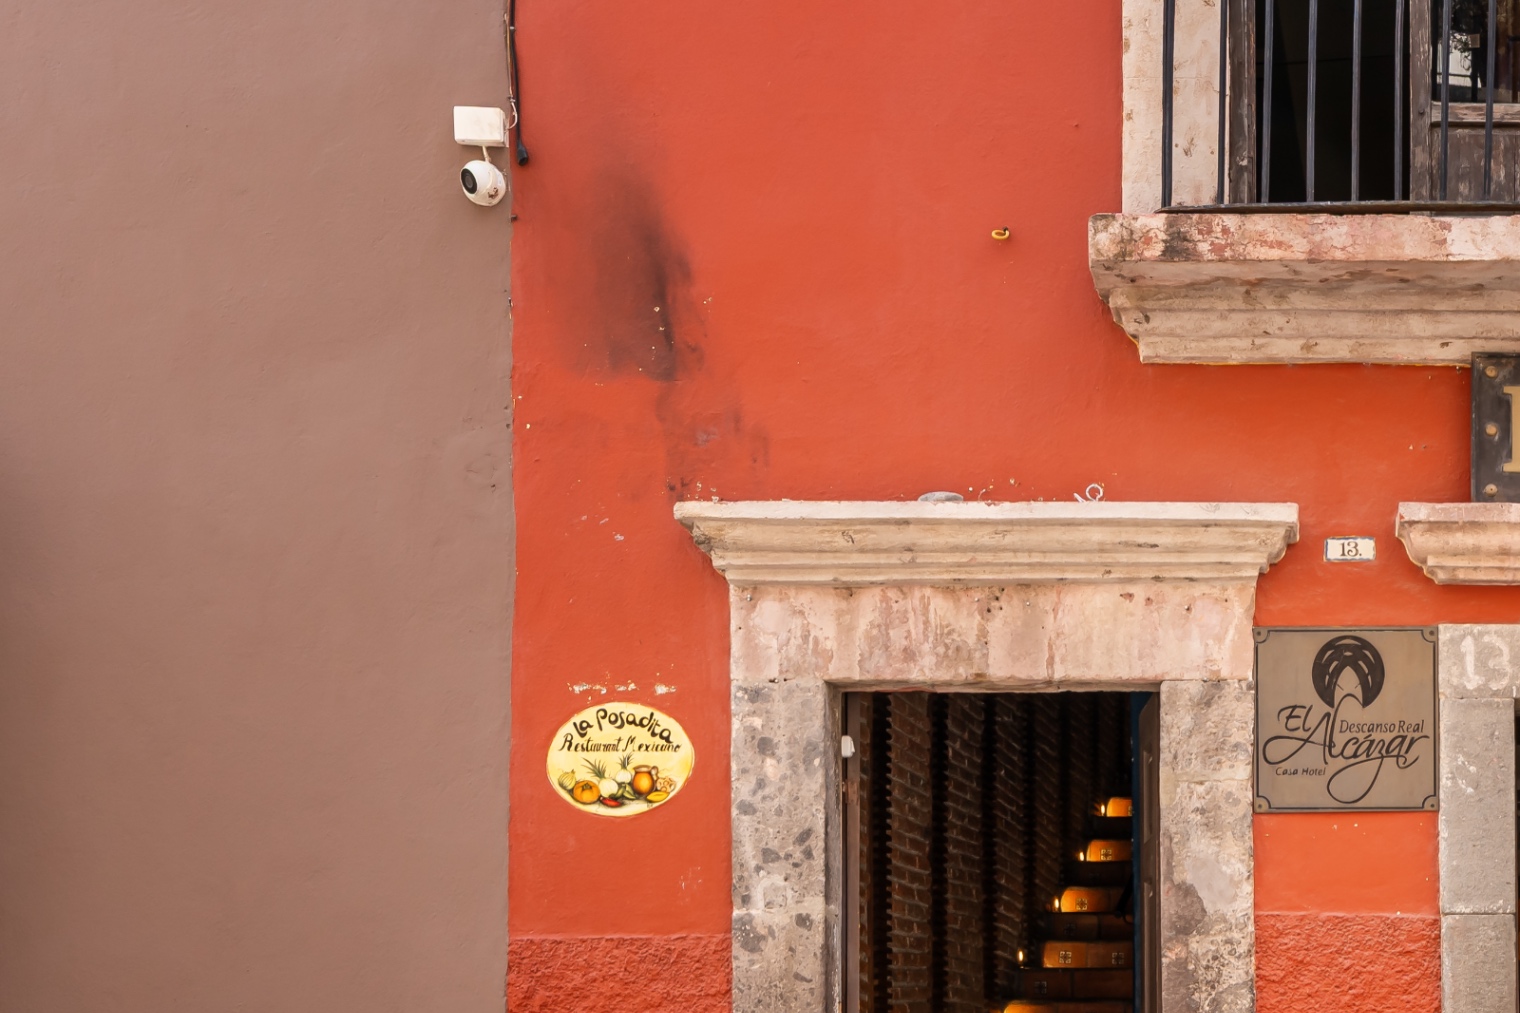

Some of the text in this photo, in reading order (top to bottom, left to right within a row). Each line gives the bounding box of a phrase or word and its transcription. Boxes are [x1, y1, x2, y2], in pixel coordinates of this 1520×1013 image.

[1459, 635, 1512, 691] 13
[596, 708, 674, 744] Posadita
[1277, 704, 1313, 733] El
[1339, 719, 1425, 734] Descanso Real
[558, 732, 682, 753] Restaurant Mexicano
[1262, 693, 1430, 804] Alcázar
[1275, 767, 1326, 776] Casa Hotel
